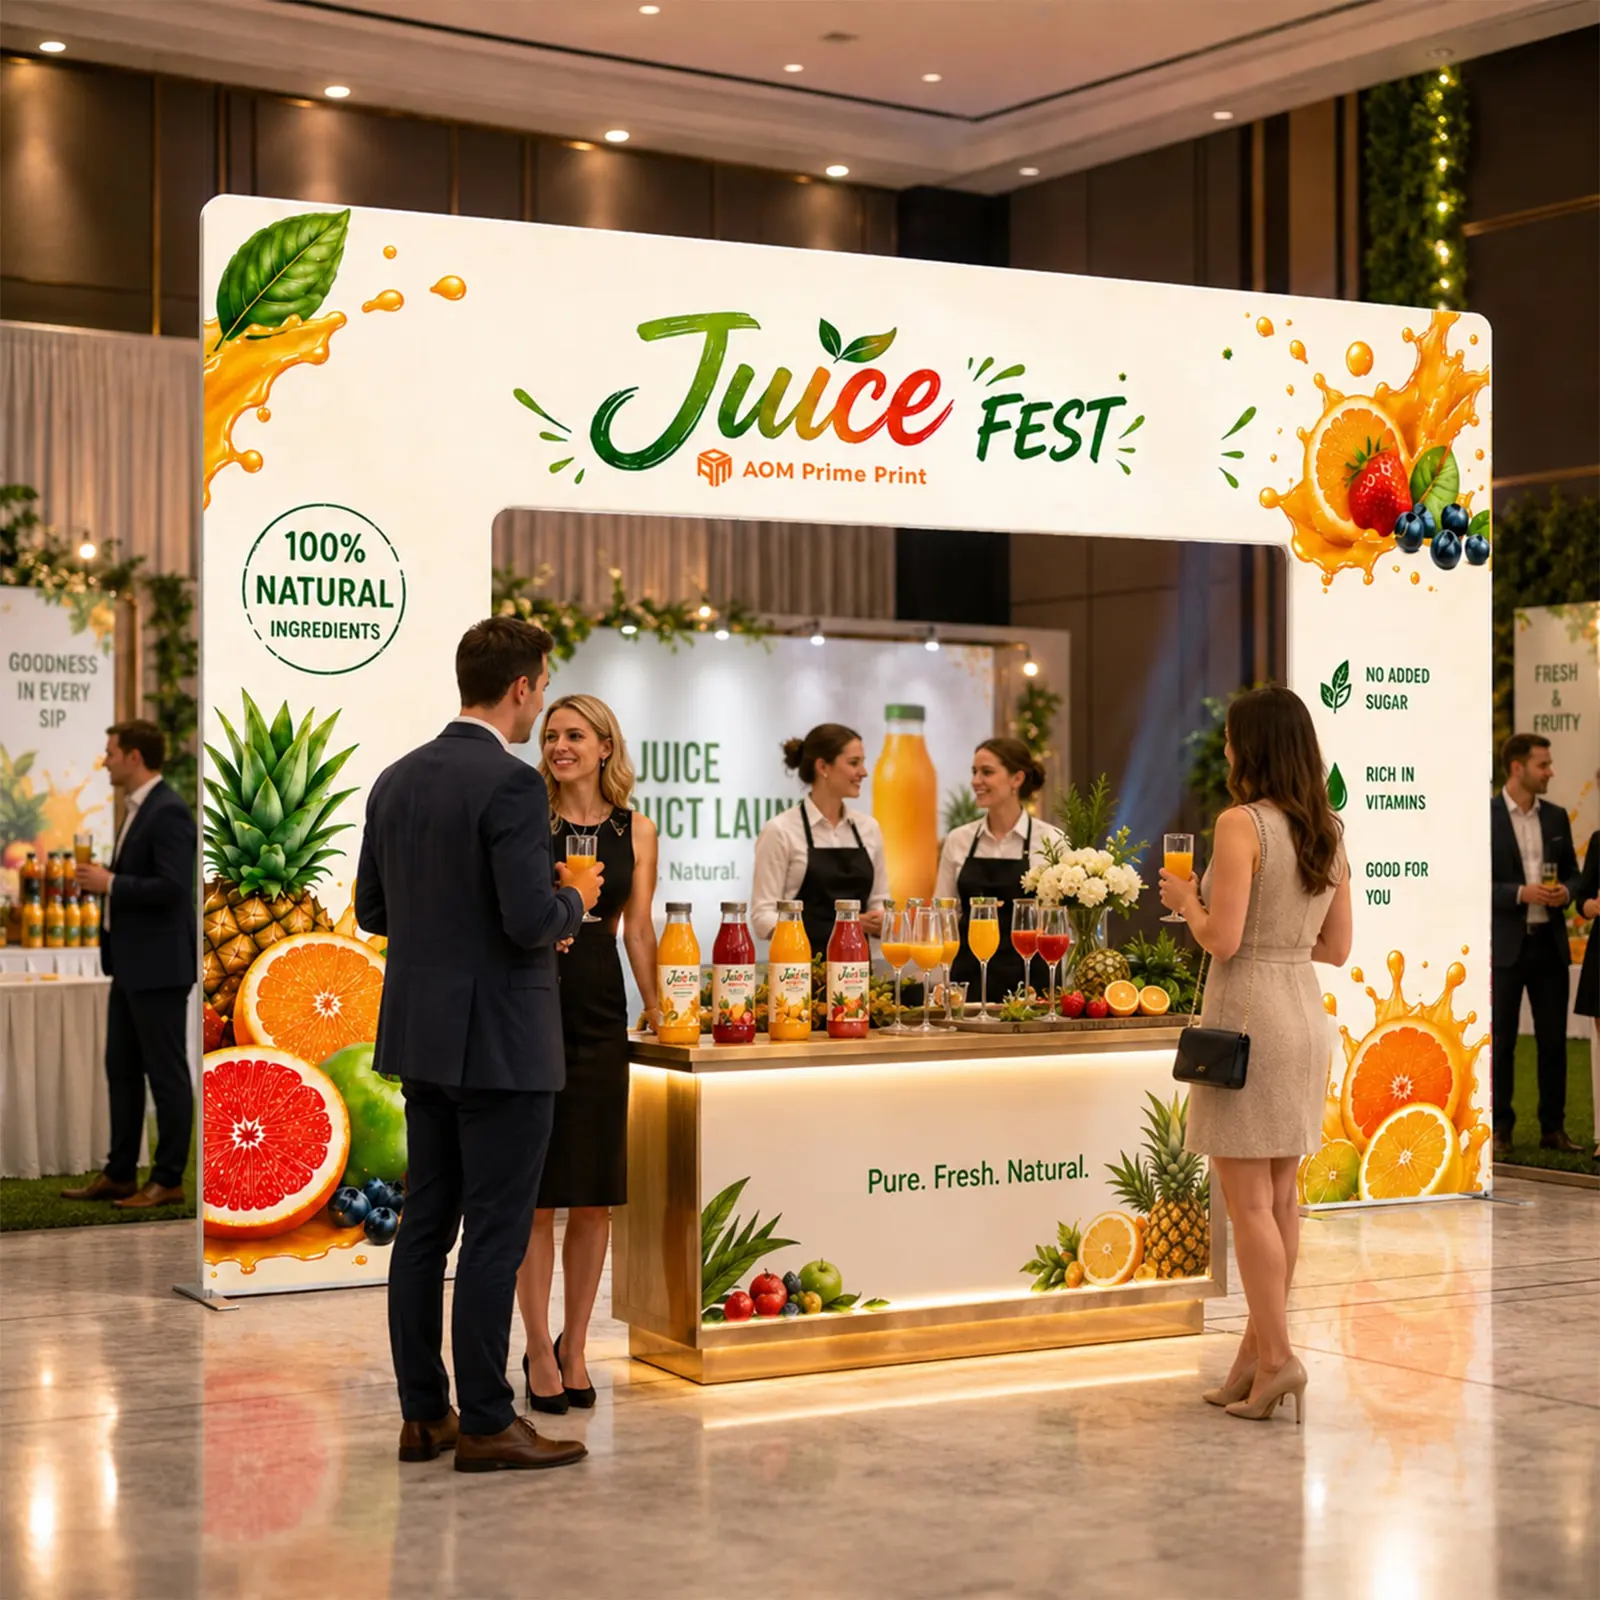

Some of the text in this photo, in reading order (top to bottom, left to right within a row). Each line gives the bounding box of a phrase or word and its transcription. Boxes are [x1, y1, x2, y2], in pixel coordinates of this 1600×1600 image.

[590, 312, 1126, 471] Juice FEST
[743, 461, 794, 479] AOM
[802, 463, 866, 482] Prime
[875, 466, 927, 485] Print
[285, 531, 366, 564] 100%
[256, 575, 394, 608] NATURAL
[270, 620, 381, 640] INGREDIENTS
[8, 652, 98, 674] GOODNESS
[1366, 667, 1430, 684] NO ADDED
[1535, 664, 1578, 683] FRESH
[18, 681, 91, 702] IN EVERY
[1552, 689, 1561, 707] &
[1366, 694, 1408, 710] SUGAR
[39, 709, 67, 728] SIP
[1533, 713, 1581, 732] FRUITY
[637, 741, 720, 783] JUICE
[1366, 766, 1415, 782] RICH IN
[1366, 795, 1426, 810] VITAMINS
[630, 797, 703, 839] UCT
[669, 861, 740, 881] Natural.
[1366, 861, 1429, 878] GOOD FOR
[1366, 889, 1391, 905] YOU
[868, 1153, 1089, 1194] Pure. Fresh. Natural.
